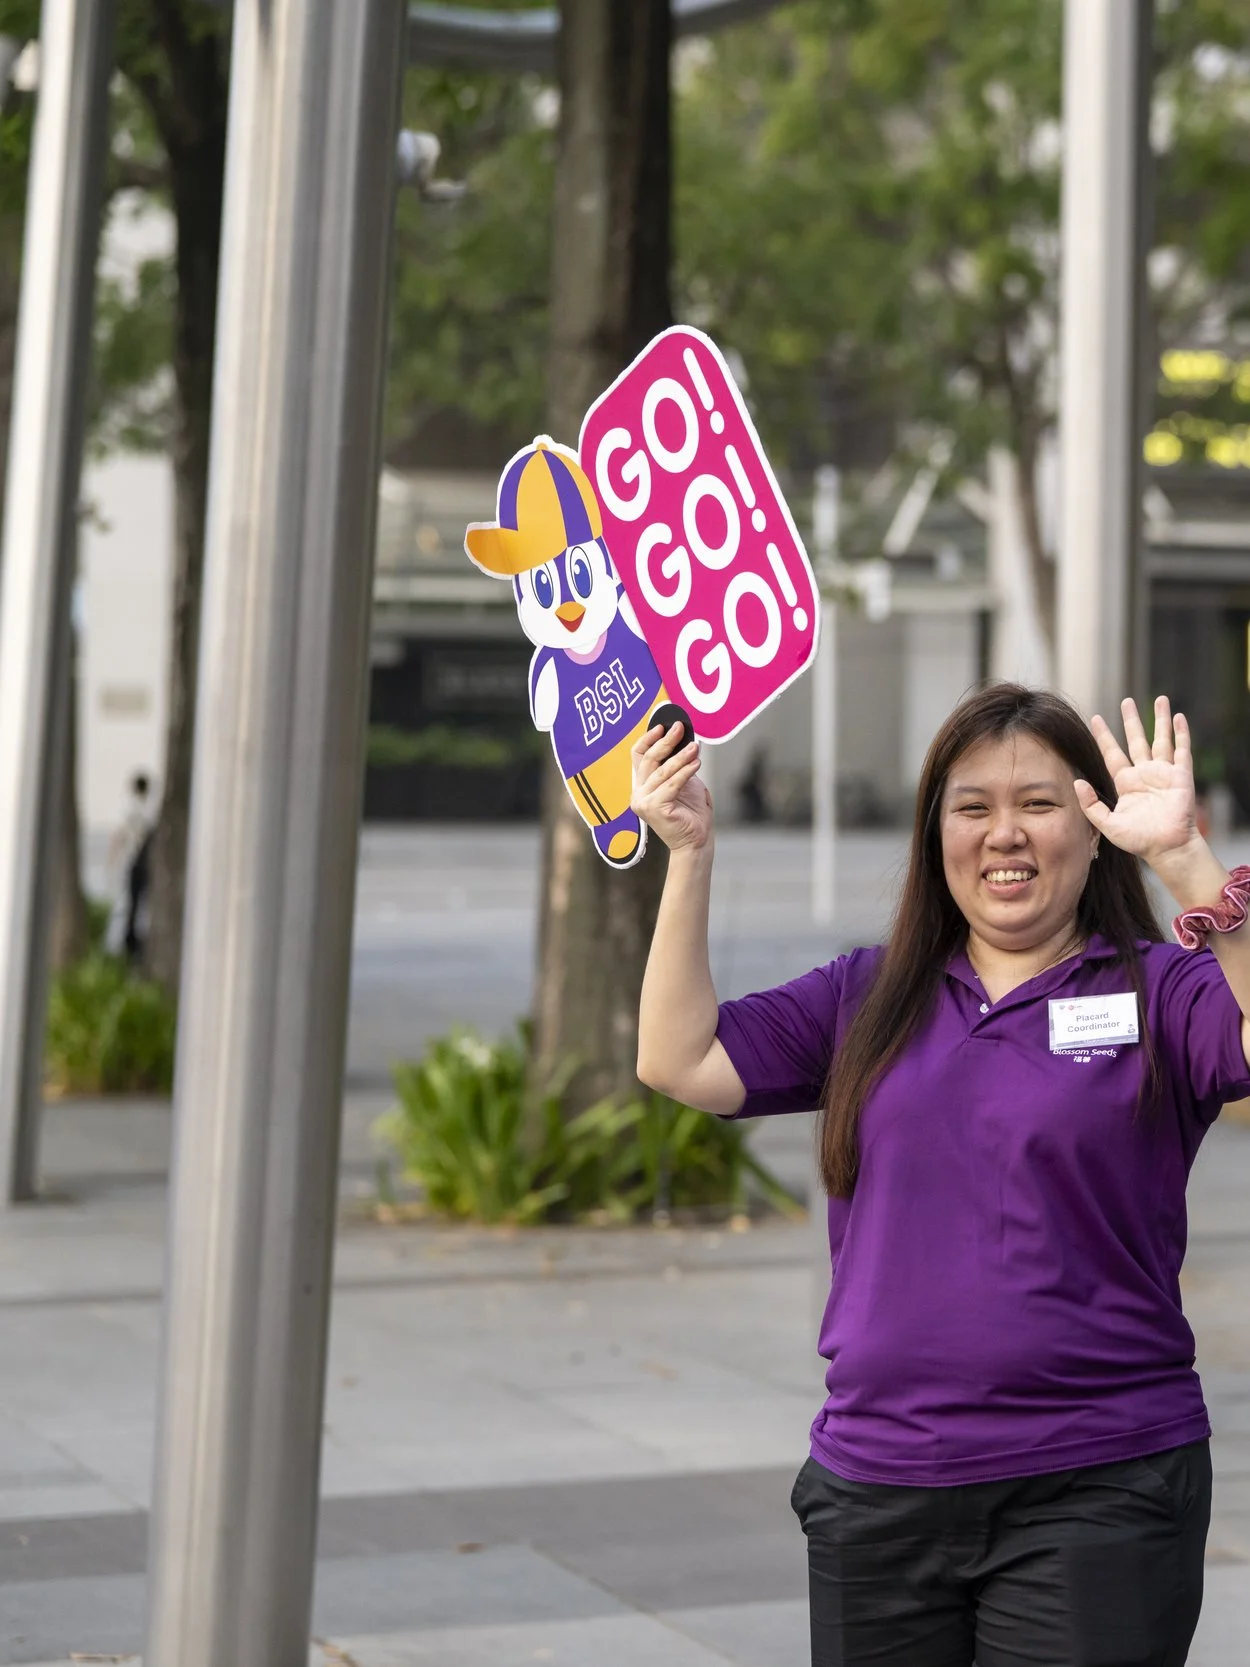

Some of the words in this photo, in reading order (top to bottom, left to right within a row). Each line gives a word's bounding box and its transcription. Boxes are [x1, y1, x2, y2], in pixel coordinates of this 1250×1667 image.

[595, 347, 725, 521] GO!
[635, 444, 766, 617] GO!
[675, 542, 808, 714] GO!
[574, 659, 645, 746] BSL
[1053, 1048, 1089, 1056] Blossom
[1091, 1048, 1117, 1058] Seeds
[1067, 1021, 1120, 1033] Coordinator
[1076, 1012, 1109, 1022] Placard
